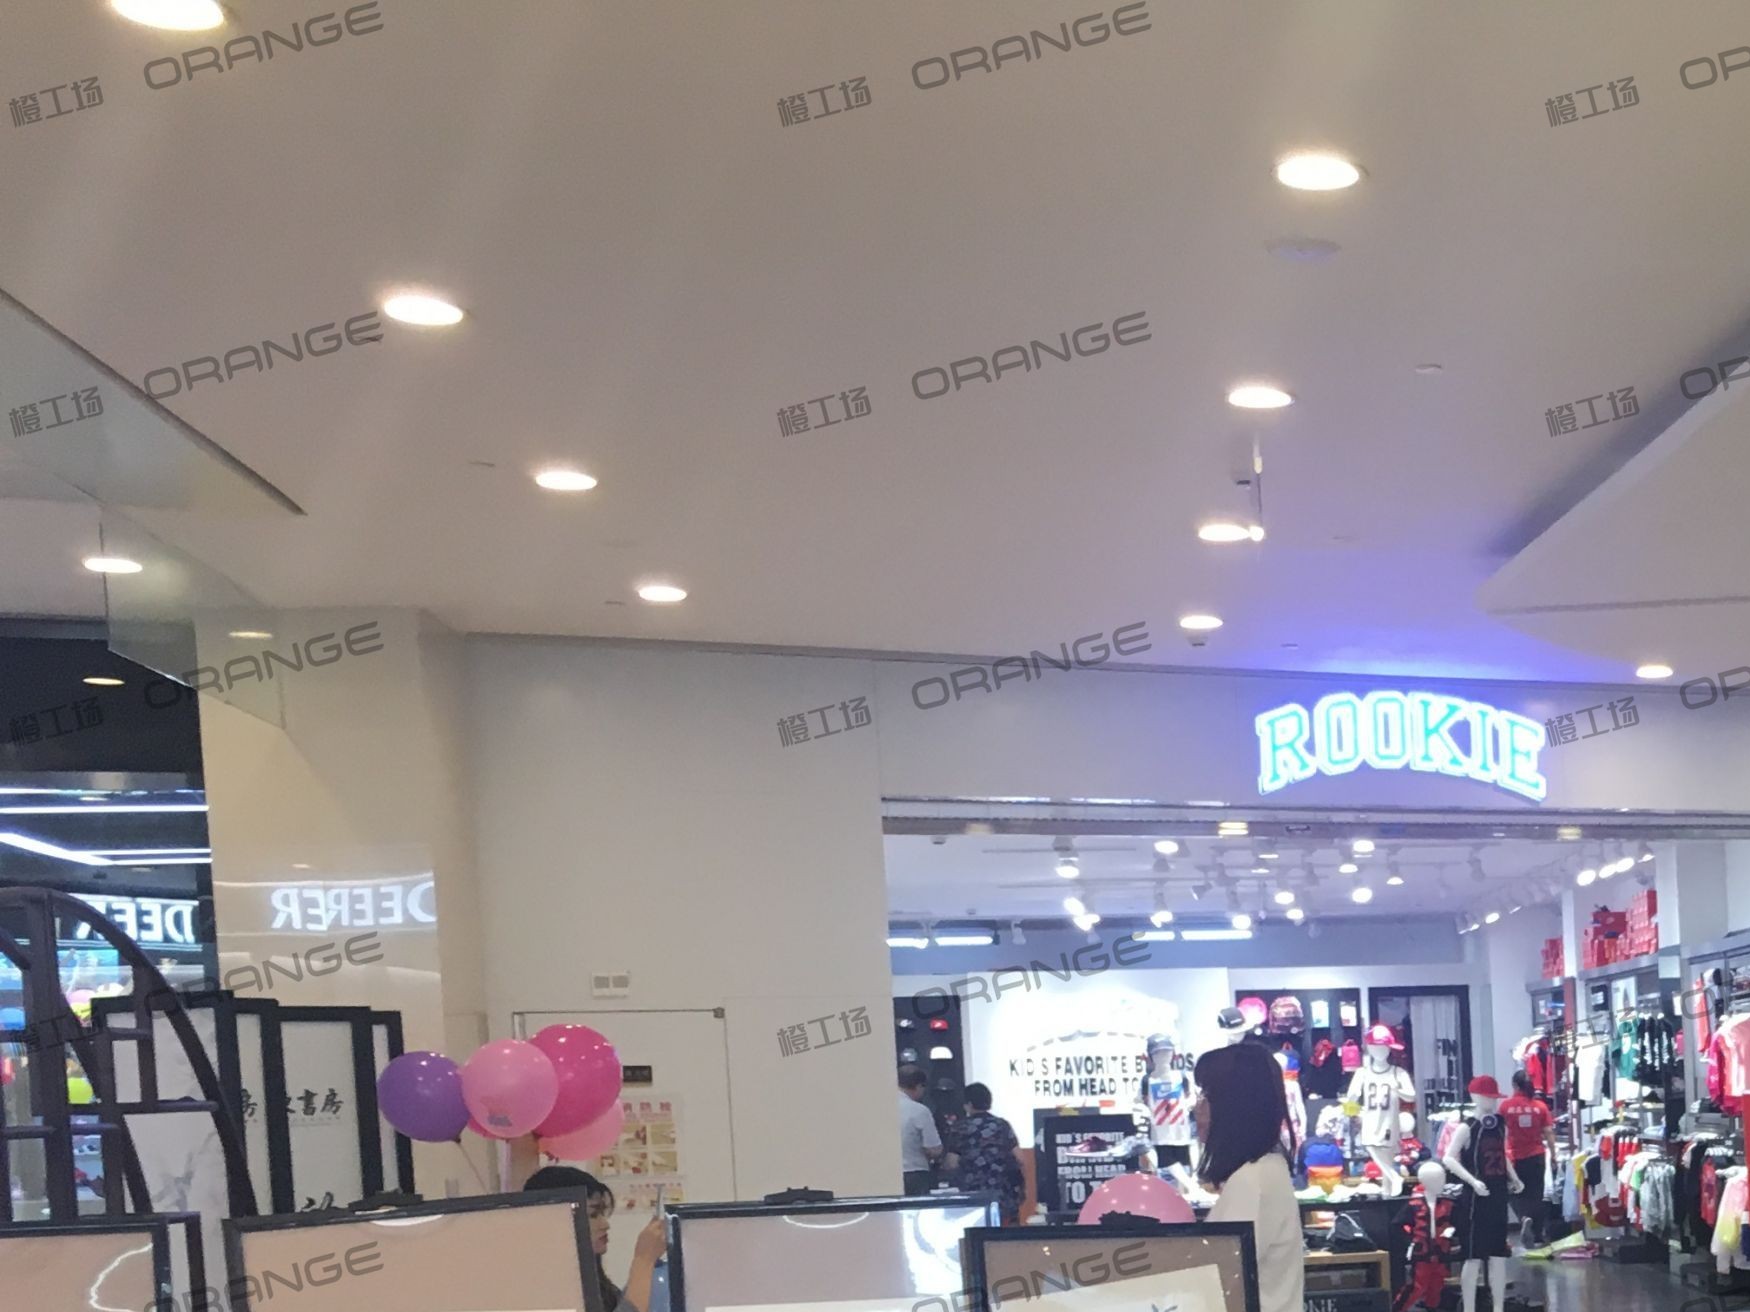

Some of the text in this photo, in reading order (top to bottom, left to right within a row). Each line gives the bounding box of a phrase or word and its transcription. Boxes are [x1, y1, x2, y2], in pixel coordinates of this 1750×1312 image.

[1255, 690, 1547, 801] ROOKIE
[1034, 1079, 1074, 1097] FROM
[1079, 1078, 1117, 1097] HEAD
[1369, 1082, 1391, 1110] 23
